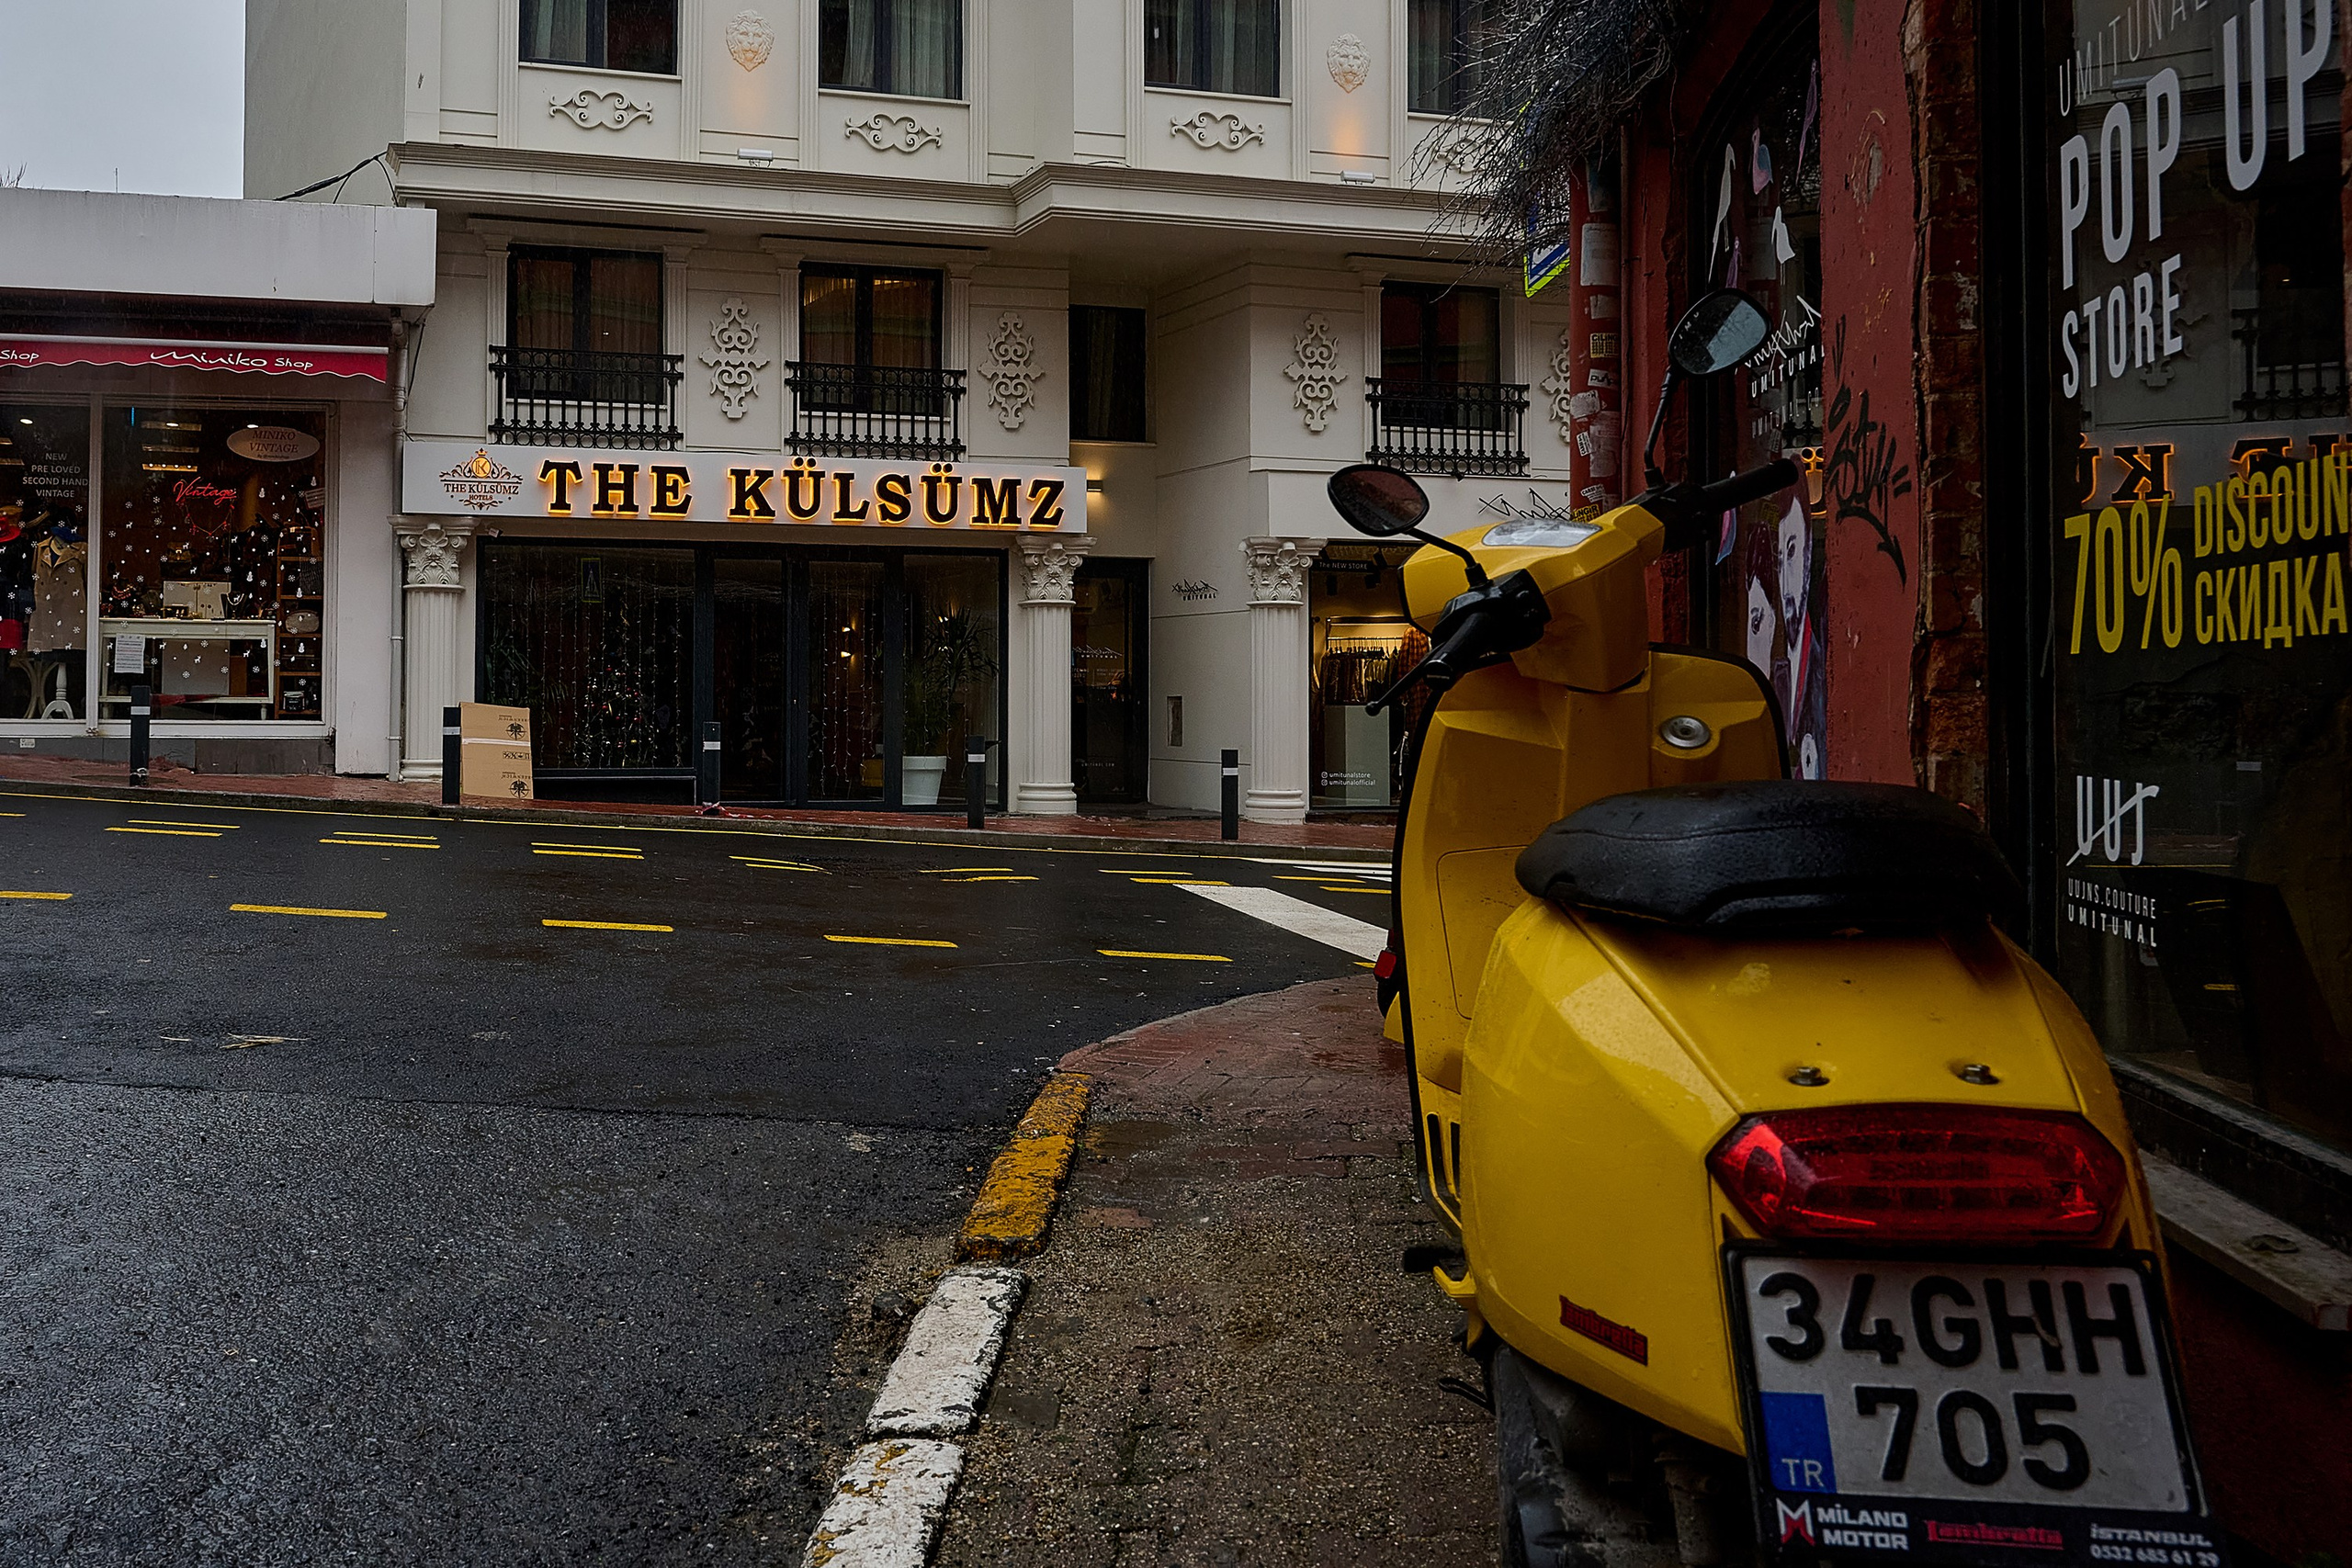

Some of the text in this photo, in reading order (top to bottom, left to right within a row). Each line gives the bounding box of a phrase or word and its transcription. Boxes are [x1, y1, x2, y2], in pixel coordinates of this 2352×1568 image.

[2059, 0, 2207, 117] UMITUNA
[2061, 0, 2332, 290] POP UP
[2063, 254, 2182, 399] STORE
[150, 351, 313, 370] Miniko Shop
[249, 442, 299, 453] VINTAGE
[252, 430, 296, 440] MINIKO
[31, 464, 81, 474] PRE LOVED
[45, 452, 68, 461] NEW
[22, 477, 88, 487] SECOND HAND
[36, 489, 74, 498] VINTAGE
[173, 476, 237, 506] Vintage
[443, 481, 519, 495] THE KÜLSÜMZ
[537, 456, 1067, 528] THE KÜLSÜMZ
[2194, 448, 2352, 558] DISCOUN
[1332, 561, 1347, 570] NEW
[2064, 493, 2184, 655] 70%
[2194, 551, 2349, 650] СКИДКА
[2067, 877, 2157, 919] UUJNS.COUTURE
[2067, 903, 2158, 948] UMITUNAL
[1853, 1385, 2091, 1492] 705
[1781, 1458, 1824, 1487] TR
[1822, 1528, 1910, 1551] MOTOR
